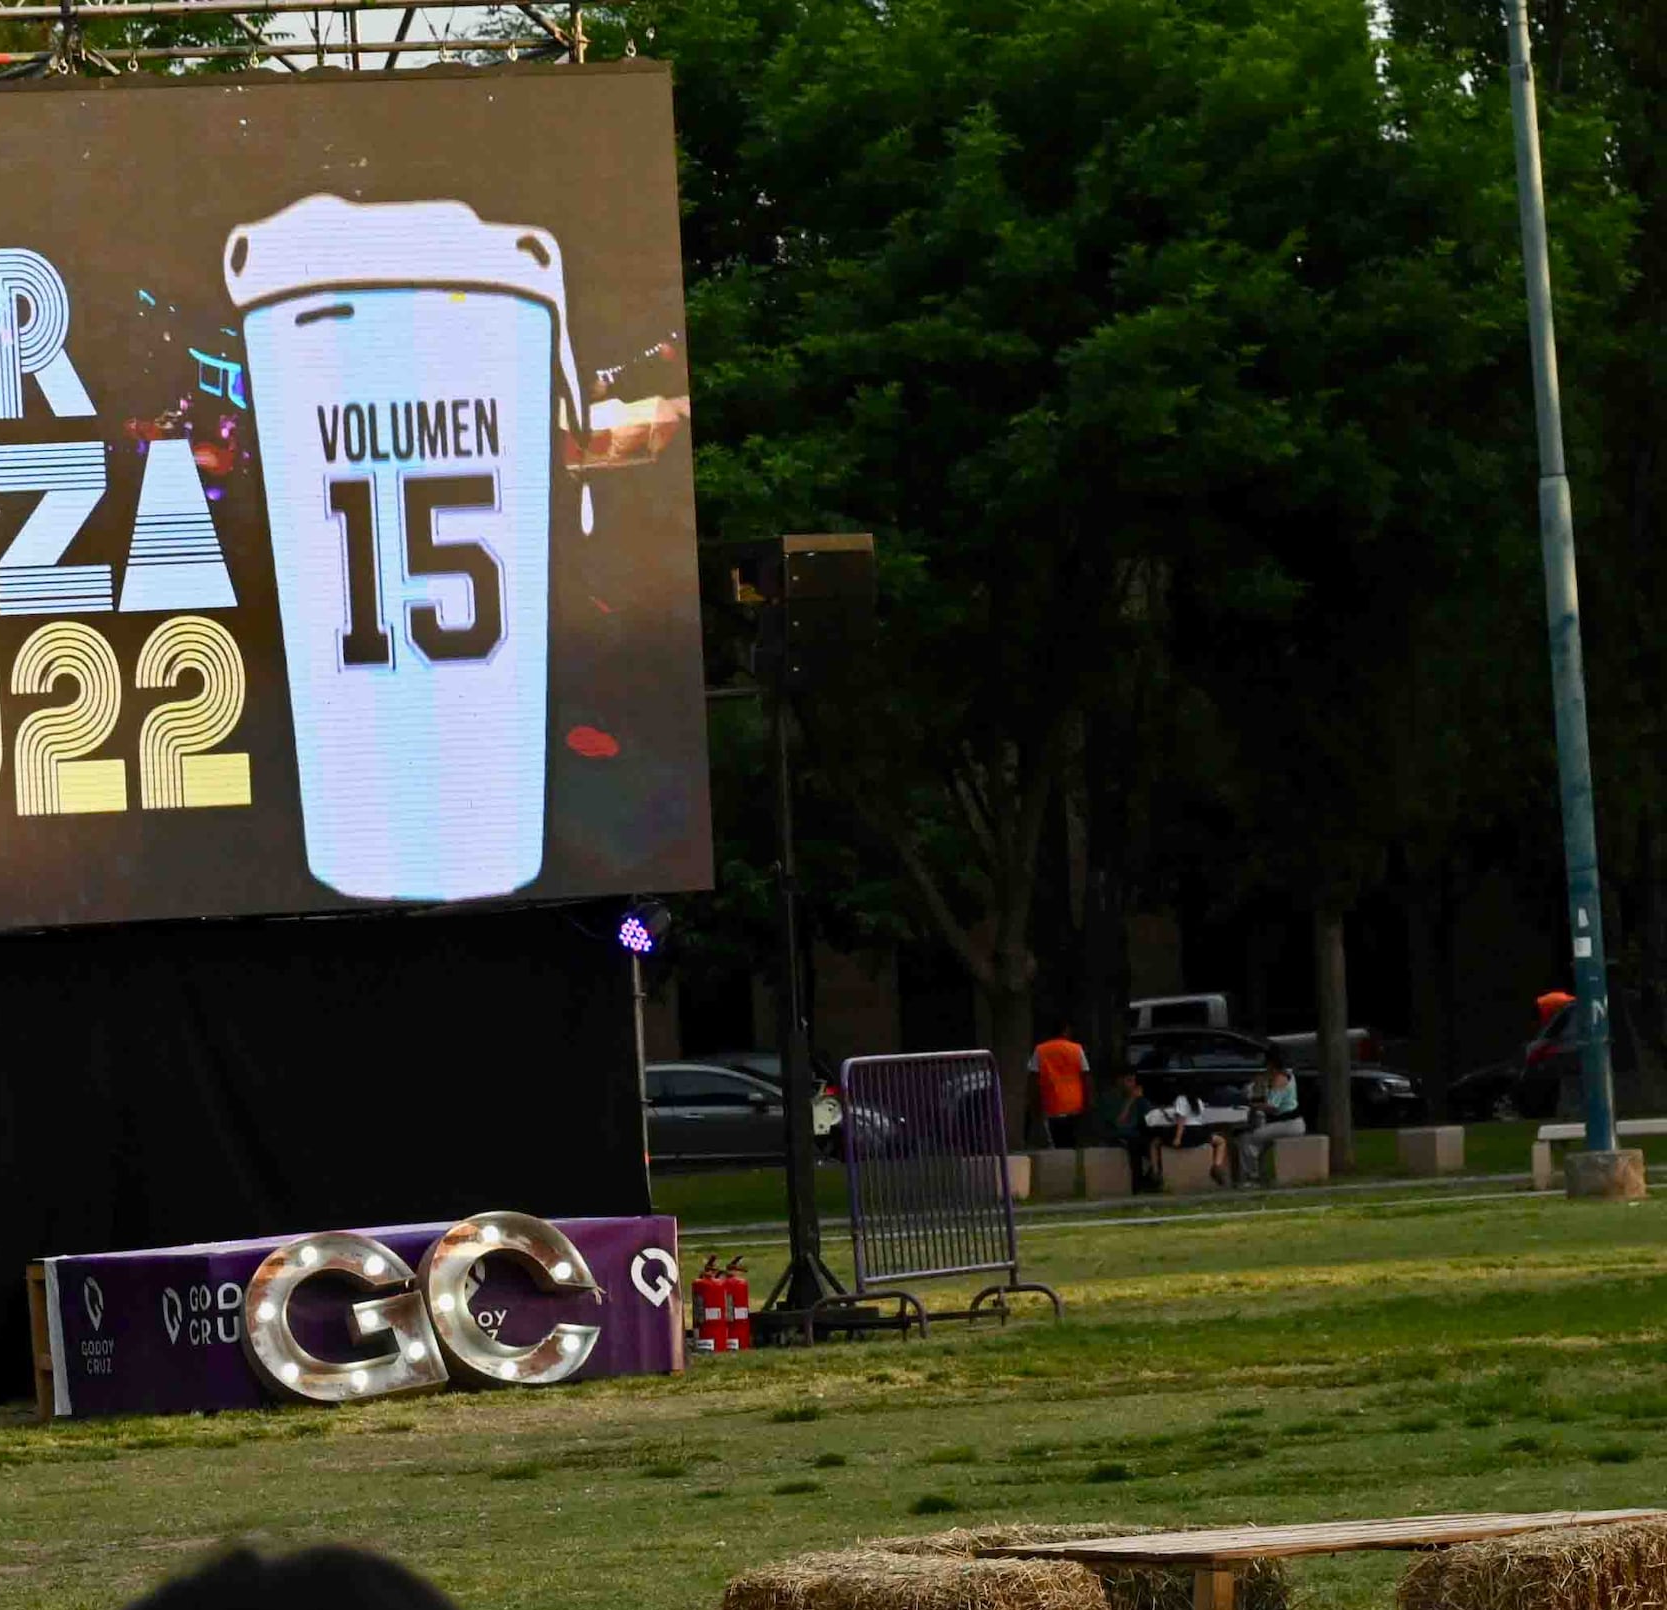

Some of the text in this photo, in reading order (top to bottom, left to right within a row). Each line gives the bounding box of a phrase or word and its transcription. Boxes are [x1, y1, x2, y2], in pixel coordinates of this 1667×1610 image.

[316, 397, 501, 463] VOLUMEN
[323, 466, 509, 674] 15
[244, 1211, 602, 1401] GC
[80, 1339, 115, 1357] GODOY
[86, 1357, 113, 1375] CRUZ
